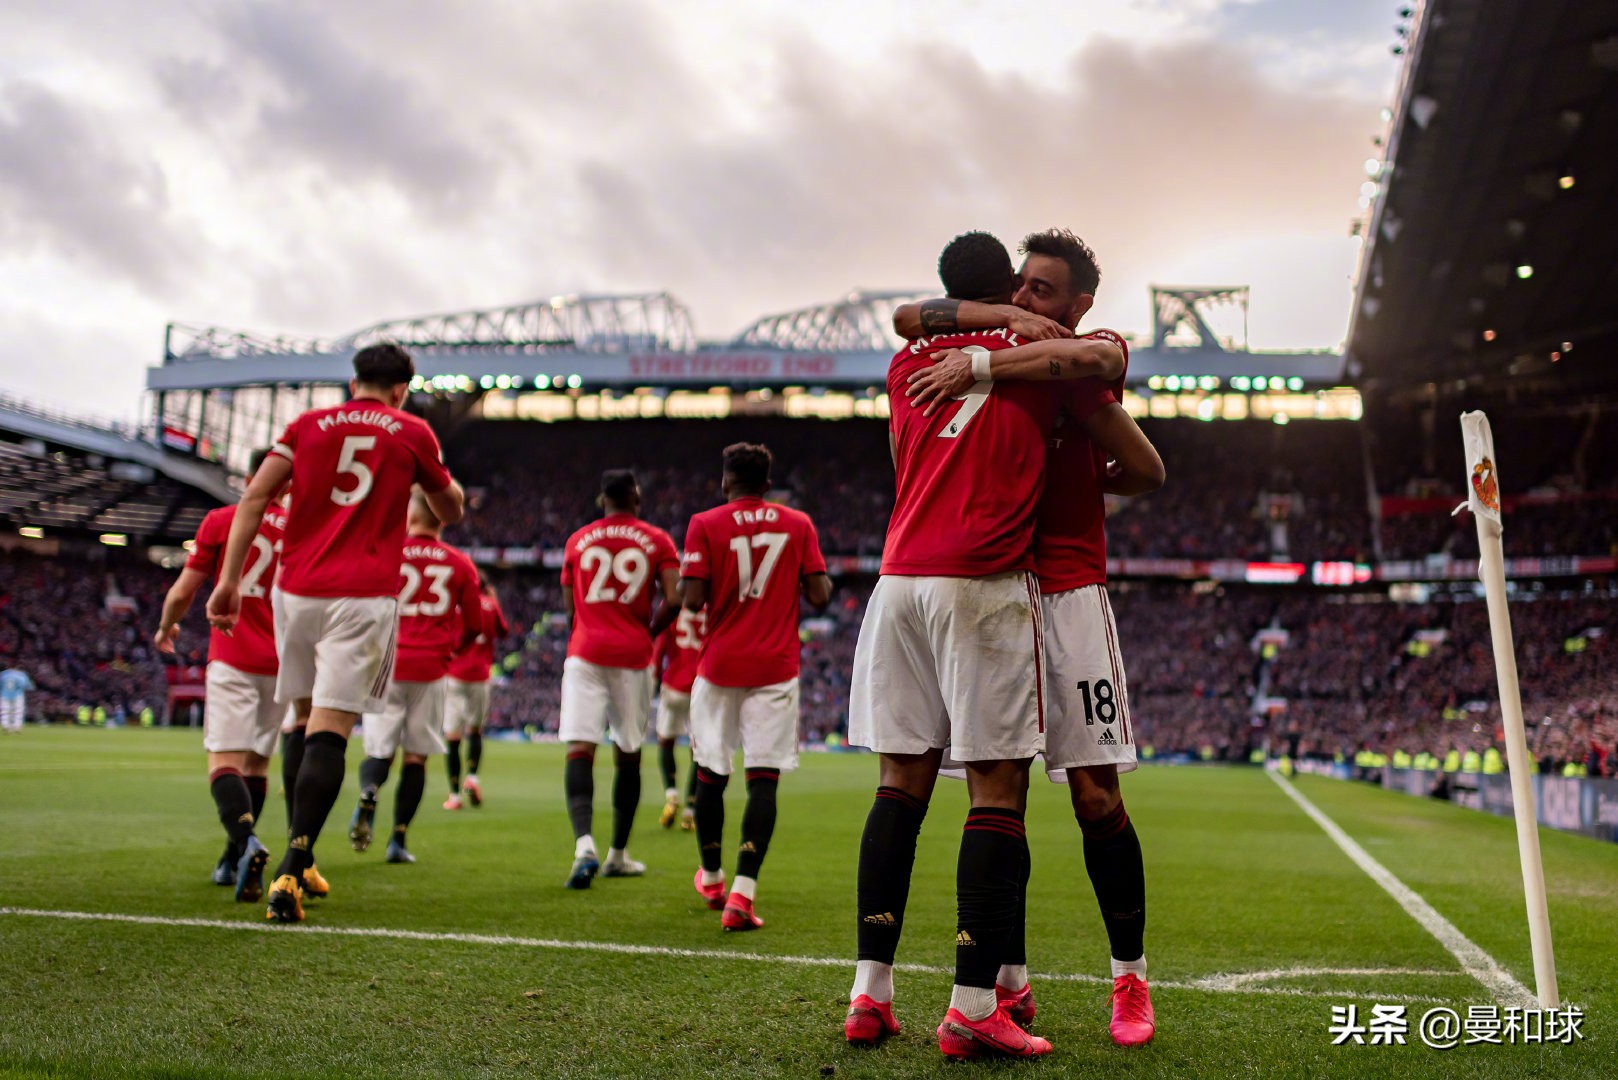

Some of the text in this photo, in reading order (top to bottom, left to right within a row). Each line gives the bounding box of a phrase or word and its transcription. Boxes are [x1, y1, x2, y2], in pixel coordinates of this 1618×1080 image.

[909, 328, 1018, 354] MIAL
[317, 410, 403, 435] MAGUIRE
[330, 435, 377, 507] 5
[732, 508, 778, 526] FRED
[240, 533, 283, 598] 2
[402, 545, 447, 561] SHAW
[580, 545, 649, 605] 29
[730, 532, 789, 603] 17
[398, 562, 454, 617] 23
[1077, 679, 1117, 725] 18
[1097, 738, 1118, 746] adidas
